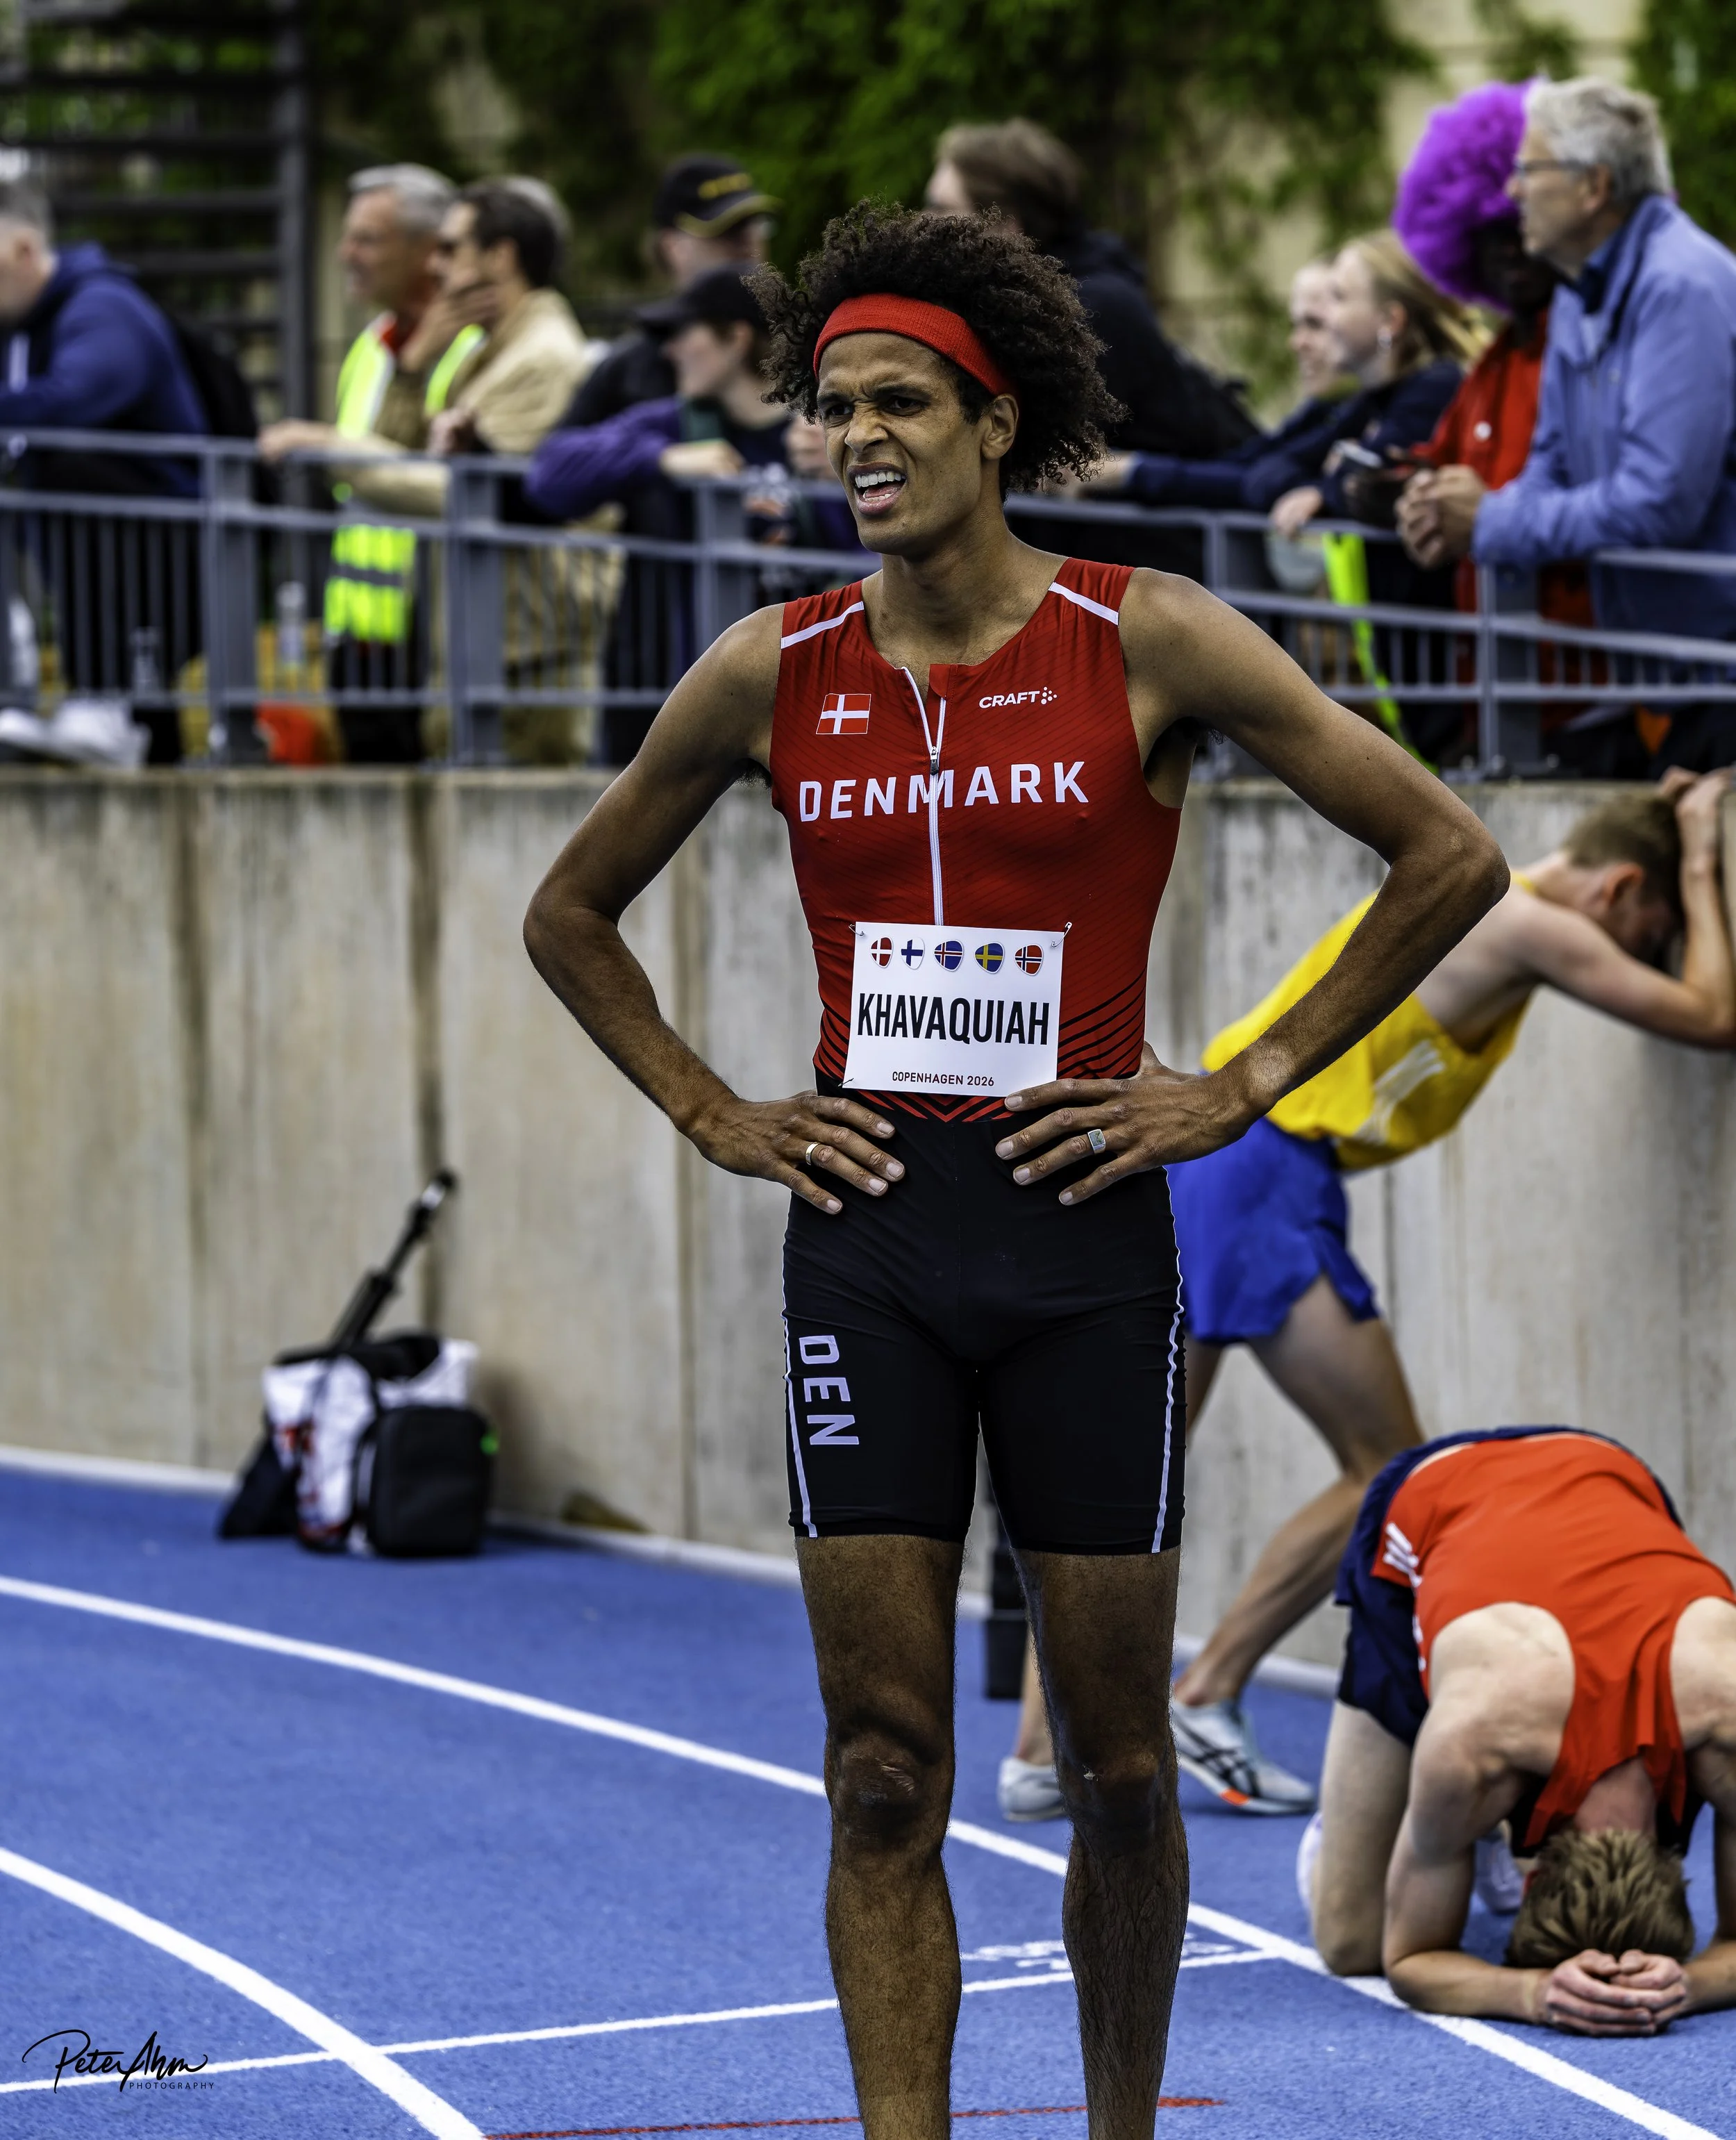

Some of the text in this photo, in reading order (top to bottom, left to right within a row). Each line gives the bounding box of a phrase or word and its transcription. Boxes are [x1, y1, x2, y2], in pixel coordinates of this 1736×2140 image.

[978, 690, 1040, 708] CRAFT
[799, 761, 1090, 822] DENMARK
[857, 993, 1050, 1045] KHAVAQUIAH
[892, 1071, 994, 1086] COPENHAGEN 2026
[799, 1335, 860, 1445] DEN
